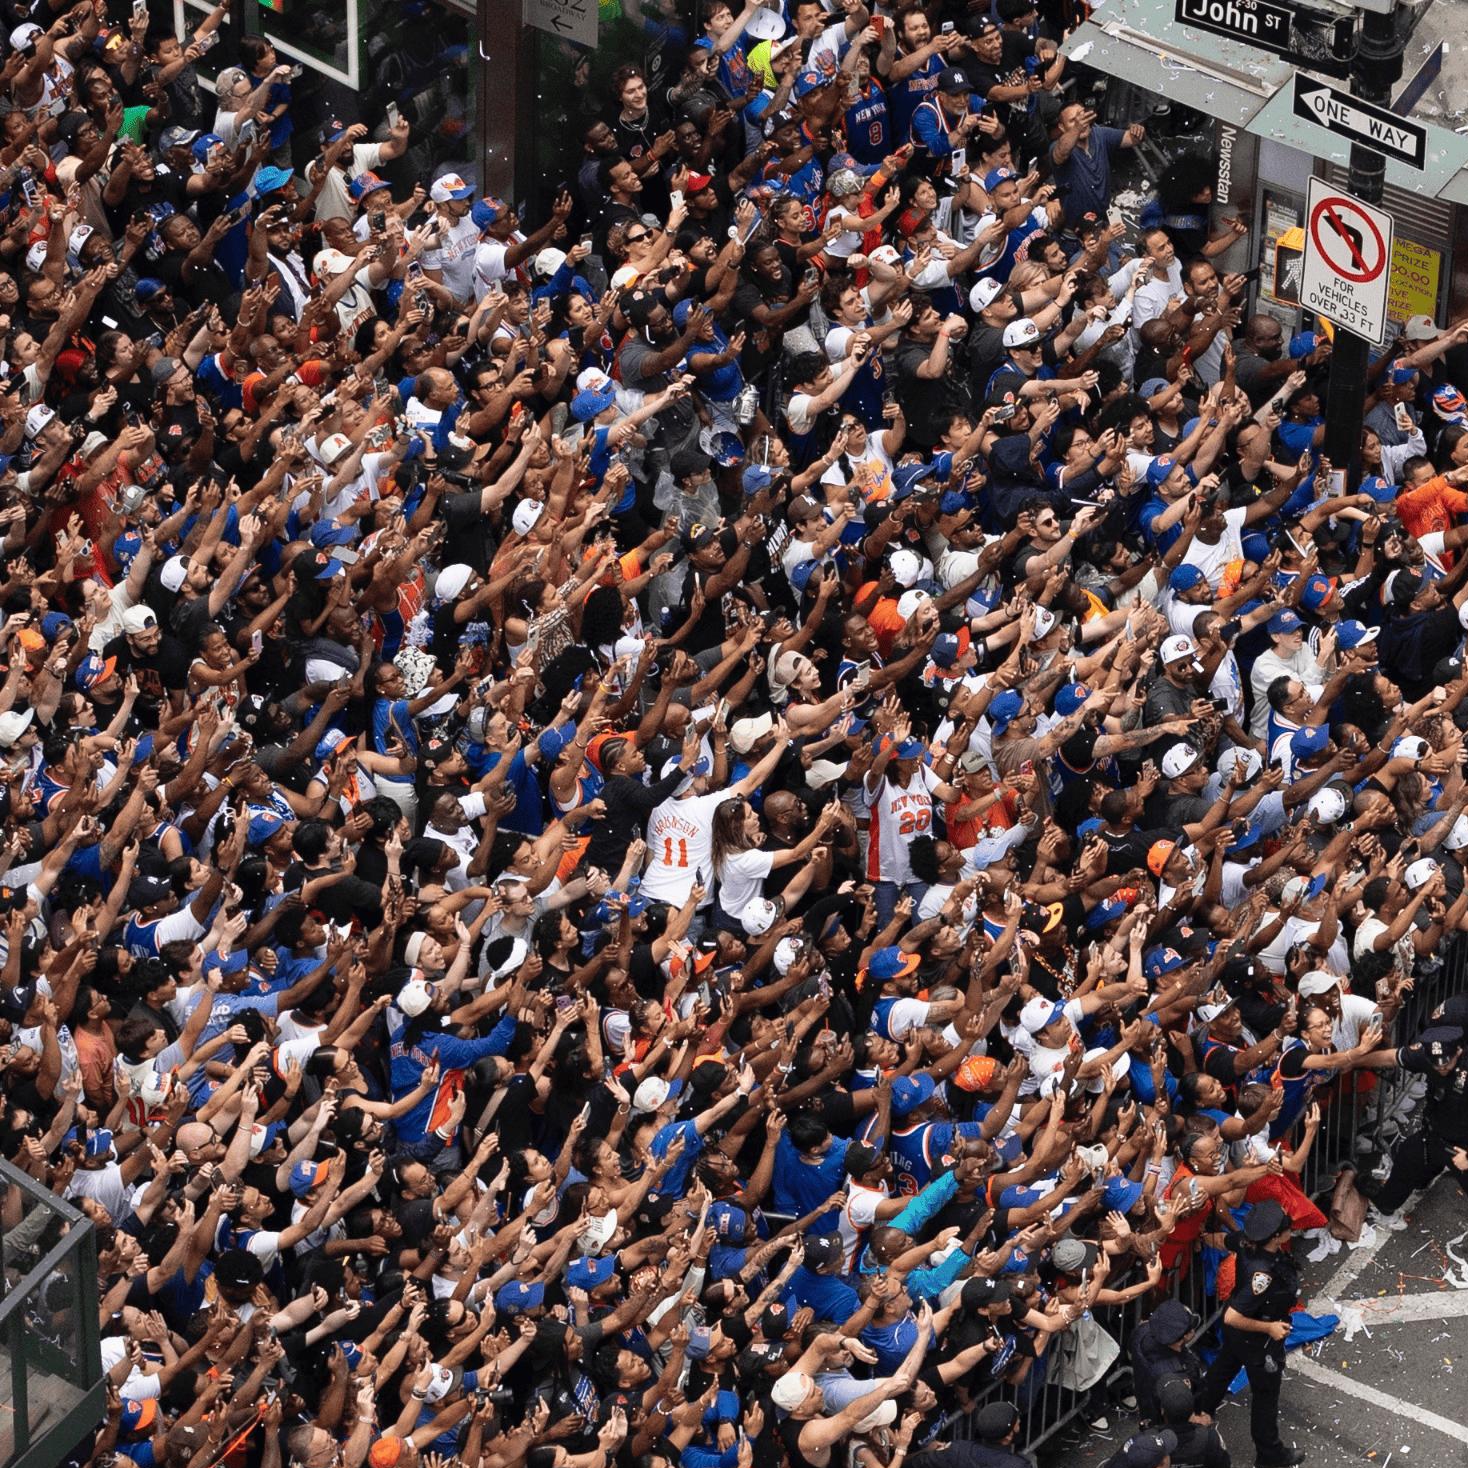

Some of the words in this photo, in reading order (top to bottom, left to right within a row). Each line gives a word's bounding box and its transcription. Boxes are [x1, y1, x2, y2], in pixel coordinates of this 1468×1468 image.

[1192, 0, 1258, 34] John
[1265, 13, 1281, 30] ST
[855, 108, 872, 123] NEW
[1314, 95, 1350, 125] ONE
[1368, 118, 1409, 149] WAY
[869, 121, 882, 146] 8
[1393, 251, 1429, 271] PRIZE
[1396, 238, 1432, 258] MEGA
[1334, 277, 1354, 295] FOR
[1318, 282, 1368, 317] VEHICLES
[1310, 293, 1337, 315] OVER
[1342, 309, 1356, 324] 33
[1361, 319, 1374, 333] FT
[655, 815, 700, 838] BRUNSON
[899, 808, 932, 835] 20
[663, 837, 688, 868] 11
